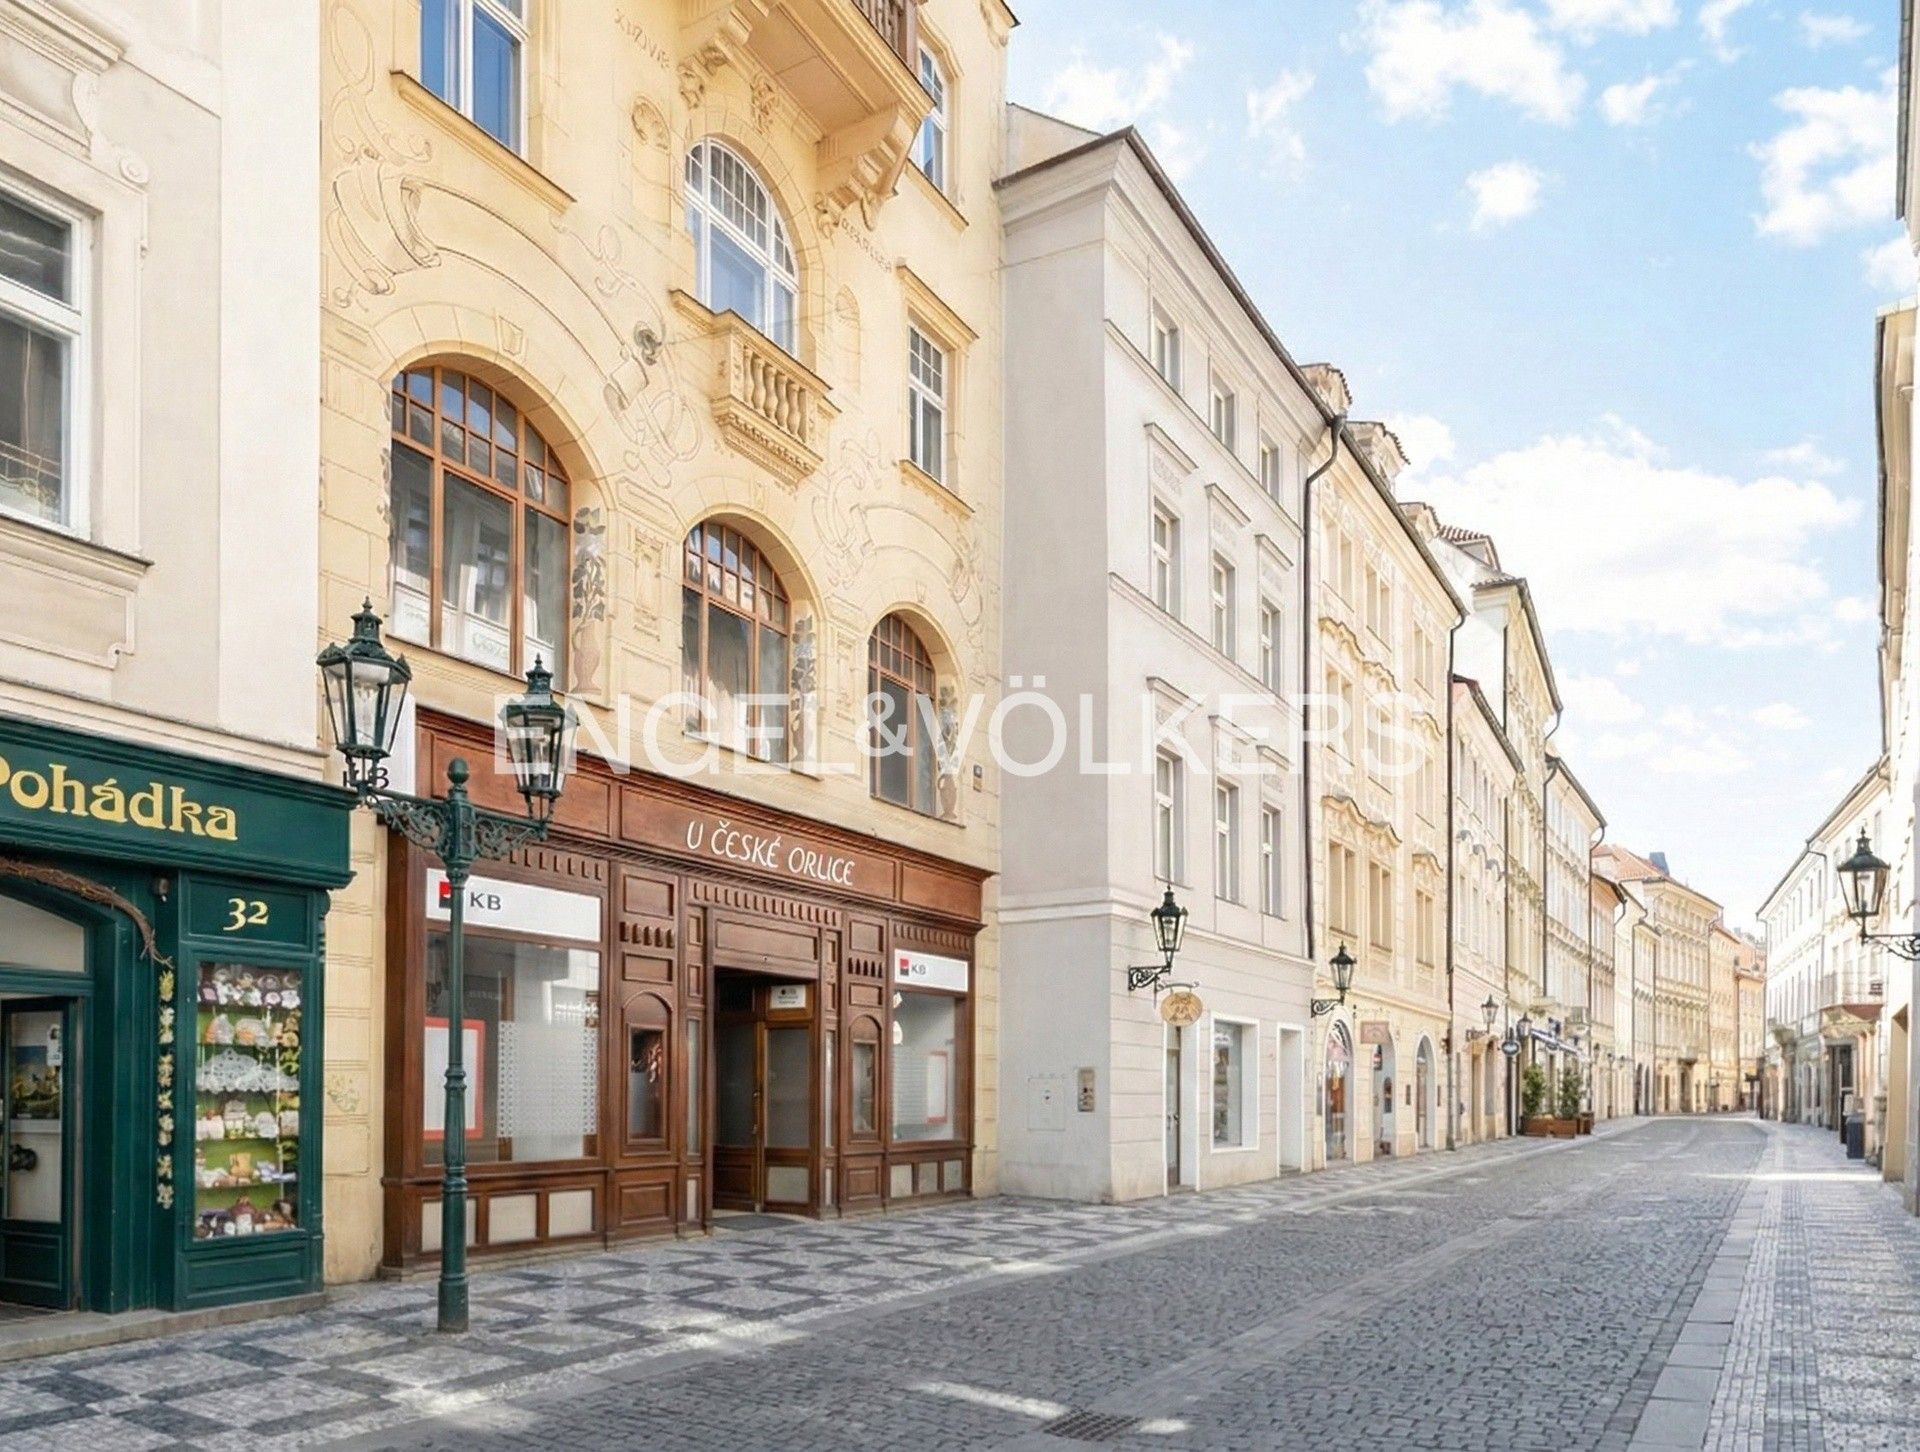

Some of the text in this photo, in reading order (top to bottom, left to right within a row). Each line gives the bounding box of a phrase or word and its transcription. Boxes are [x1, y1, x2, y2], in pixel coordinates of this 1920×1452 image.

[686, 819, 856, 887] U ČESKÉ ORLICE
[222, 897, 269, 931] 32
[469, 891, 502, 911] KB
[911, 964, 926, 976] KB
